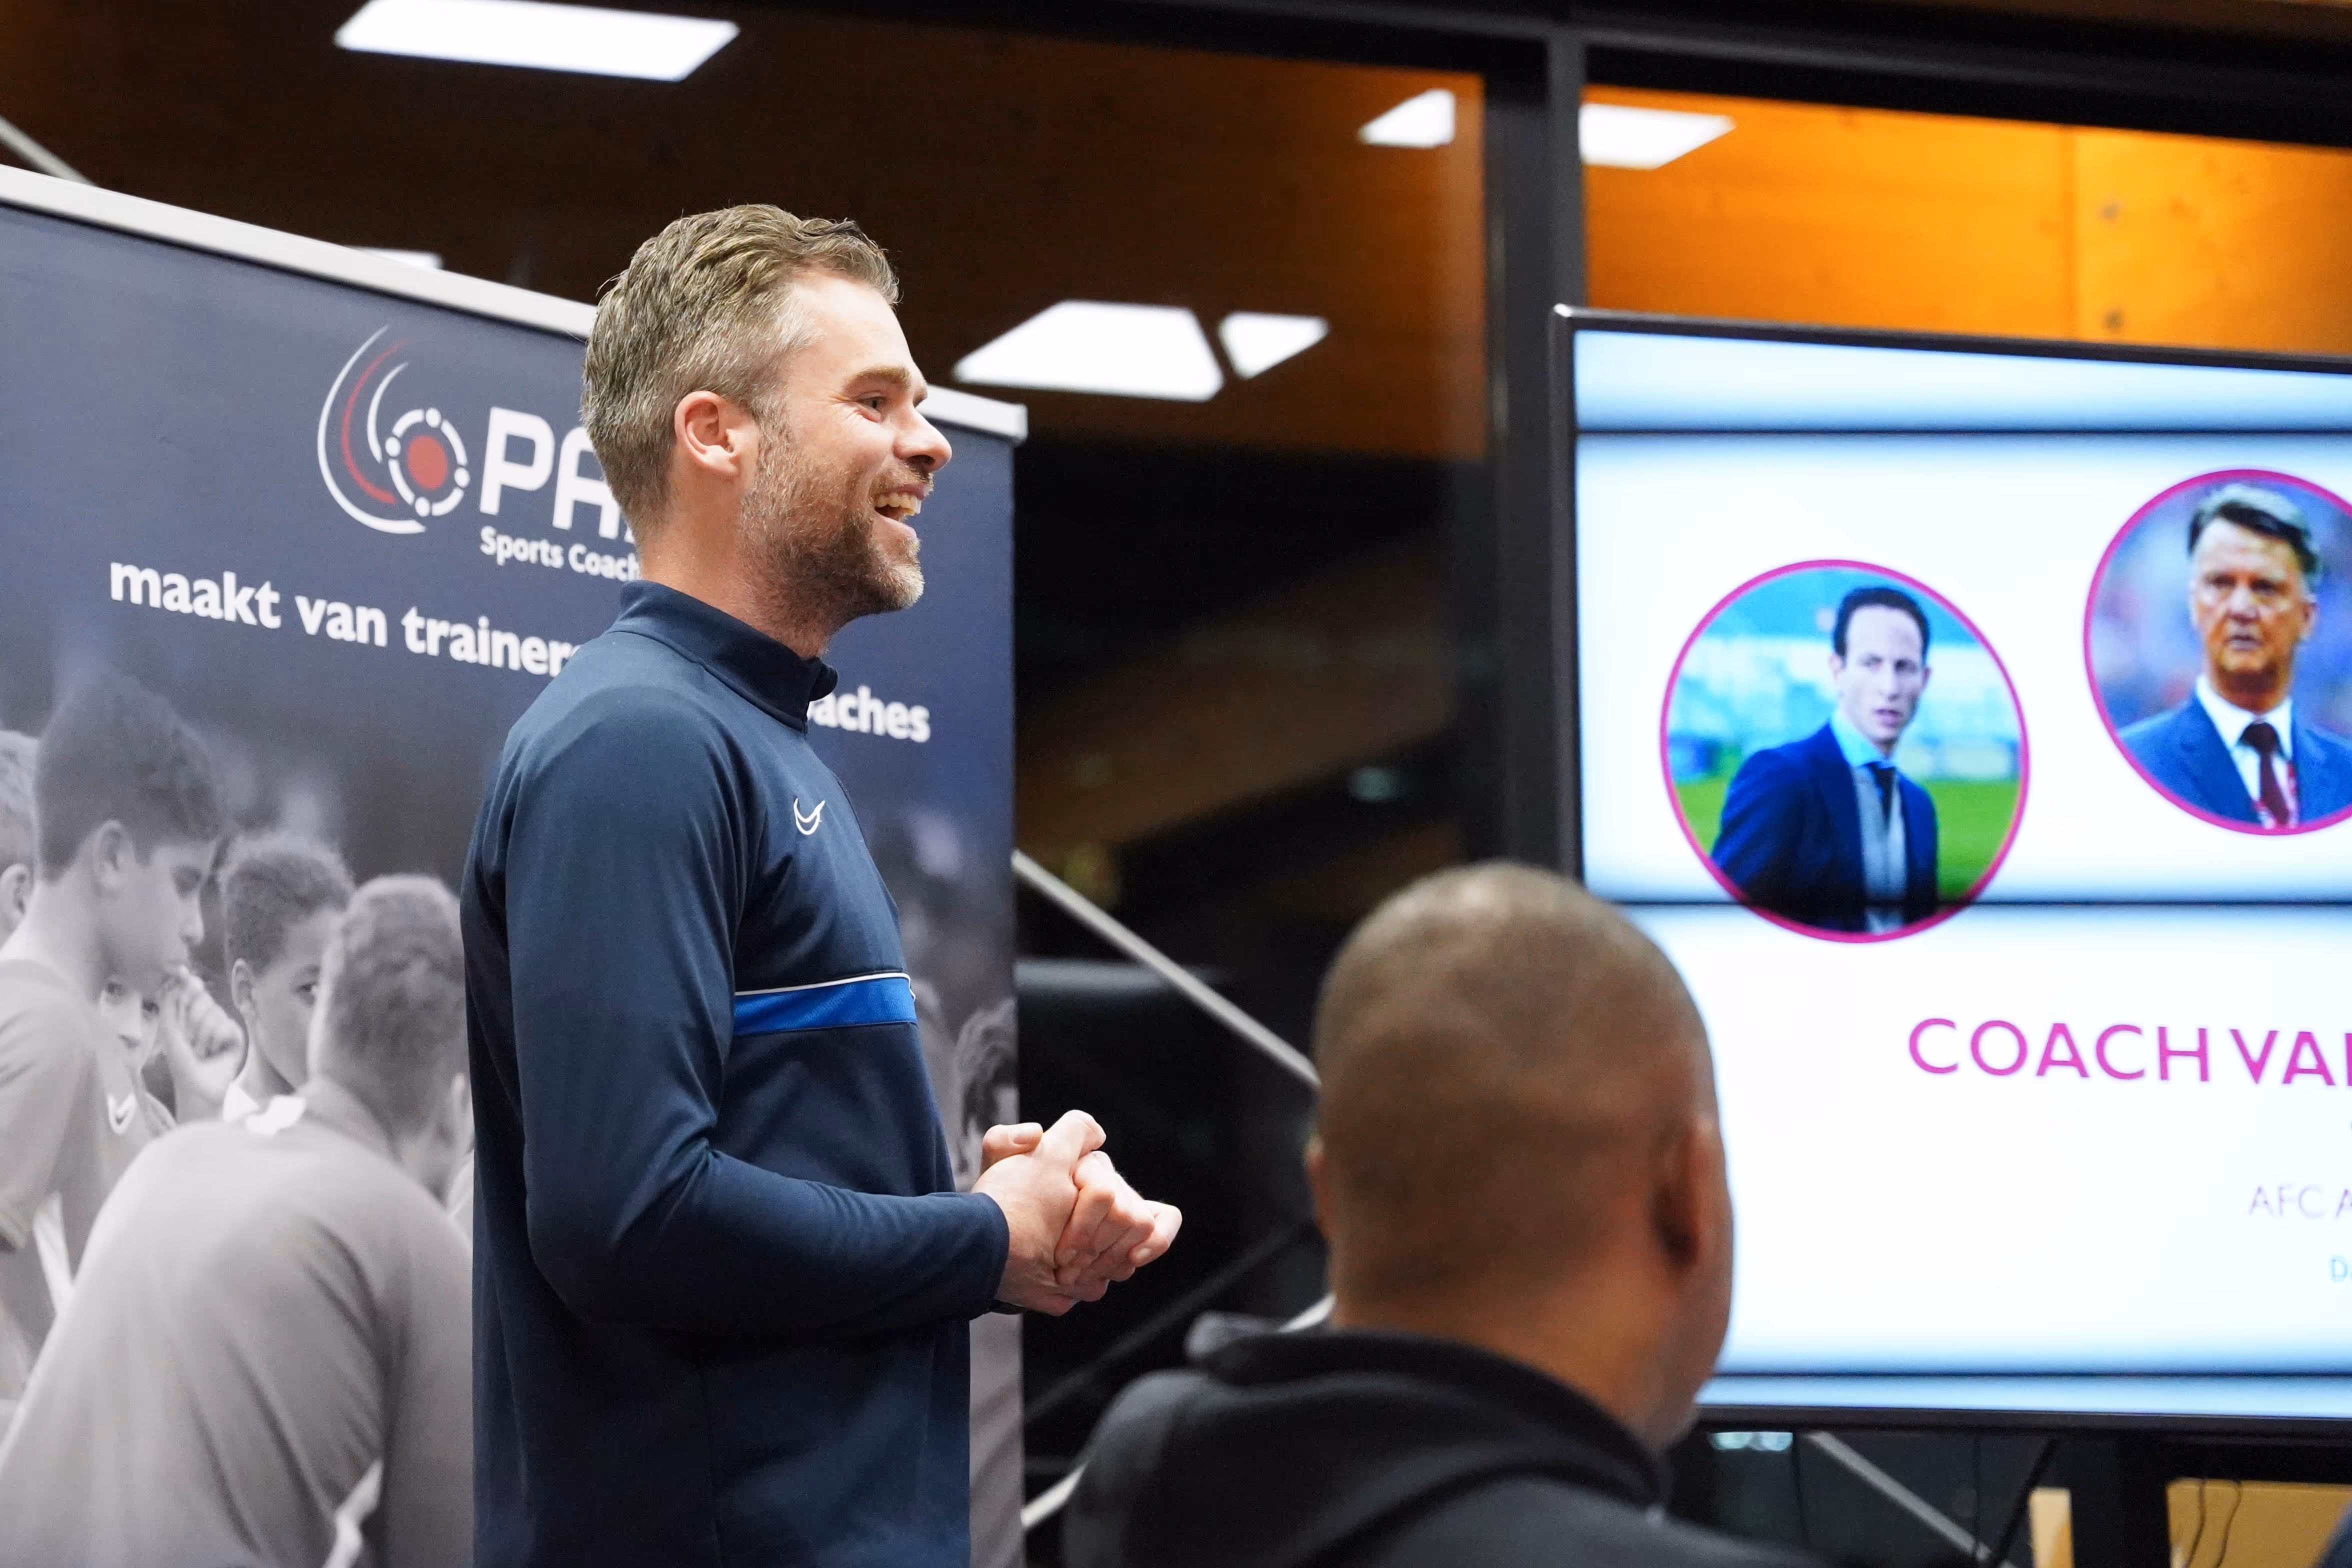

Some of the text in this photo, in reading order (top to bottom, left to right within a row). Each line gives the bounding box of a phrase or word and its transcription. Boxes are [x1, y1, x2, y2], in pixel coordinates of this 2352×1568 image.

[480, 406, 636, 544] PA
[480, 526, 564, 568] Sports
[110, 562, 930, 742] maakt van trainer aches
[1908, 1018, 2352, 1086] COACH VA
[2248, 1184, 2326, 1219] AFC
